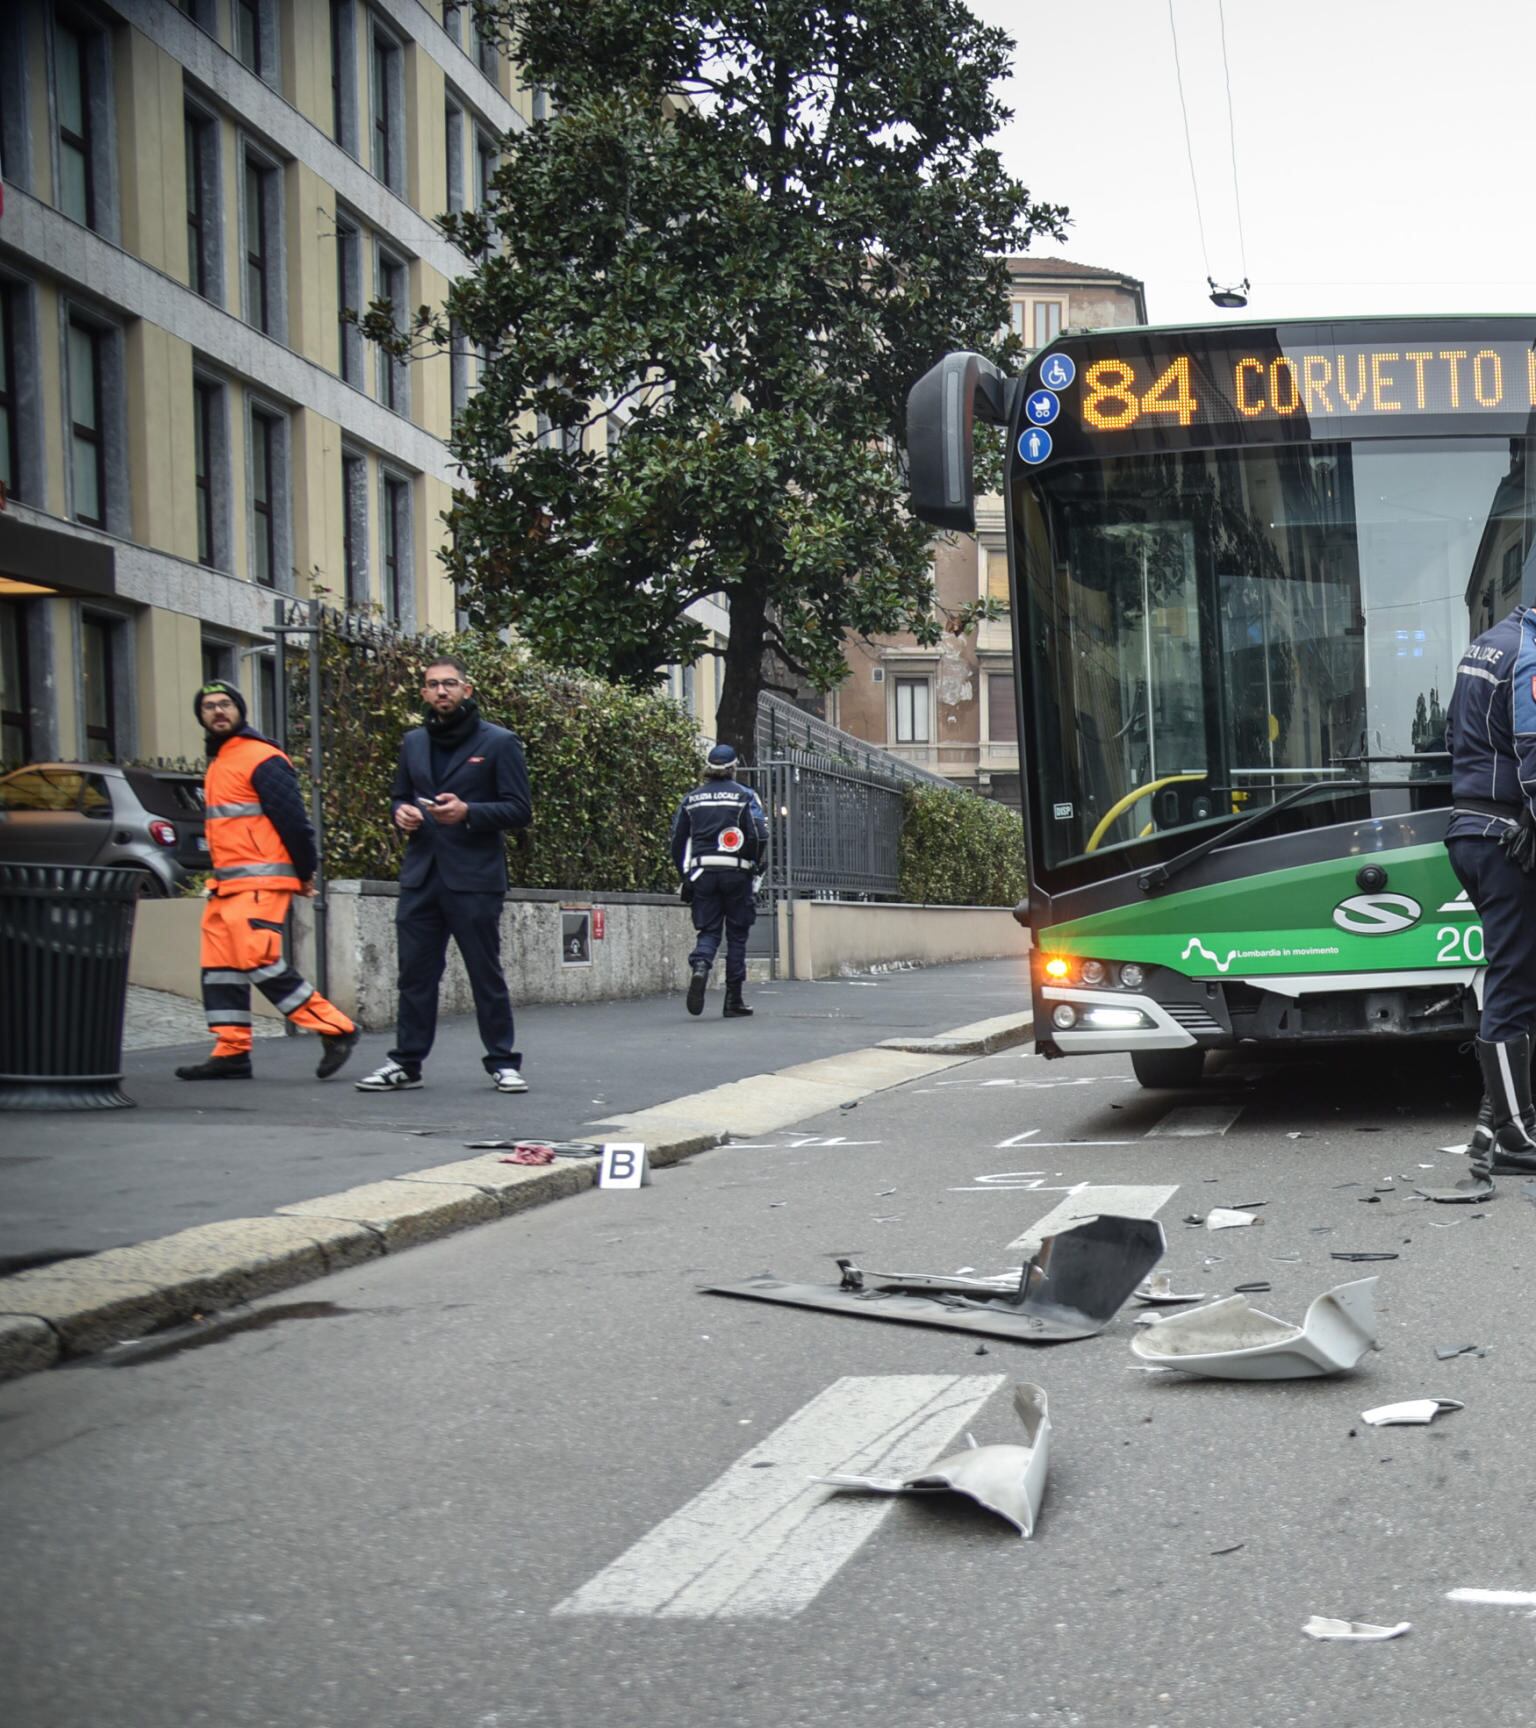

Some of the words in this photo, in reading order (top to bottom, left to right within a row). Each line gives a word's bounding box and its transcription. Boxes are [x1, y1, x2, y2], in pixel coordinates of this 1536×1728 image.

[1082, 355, 1197, 429] 84
[1234, 348, 1503, 417] CORVETTO
[713, 791, 740, 800] LOCALE
[1237, 948, 1281, 958] Lombardia
[1282, 948, 1291, 956] in
[1292, 946, 1339, 956] movimento
[609, 1150, 636, 1179] B
